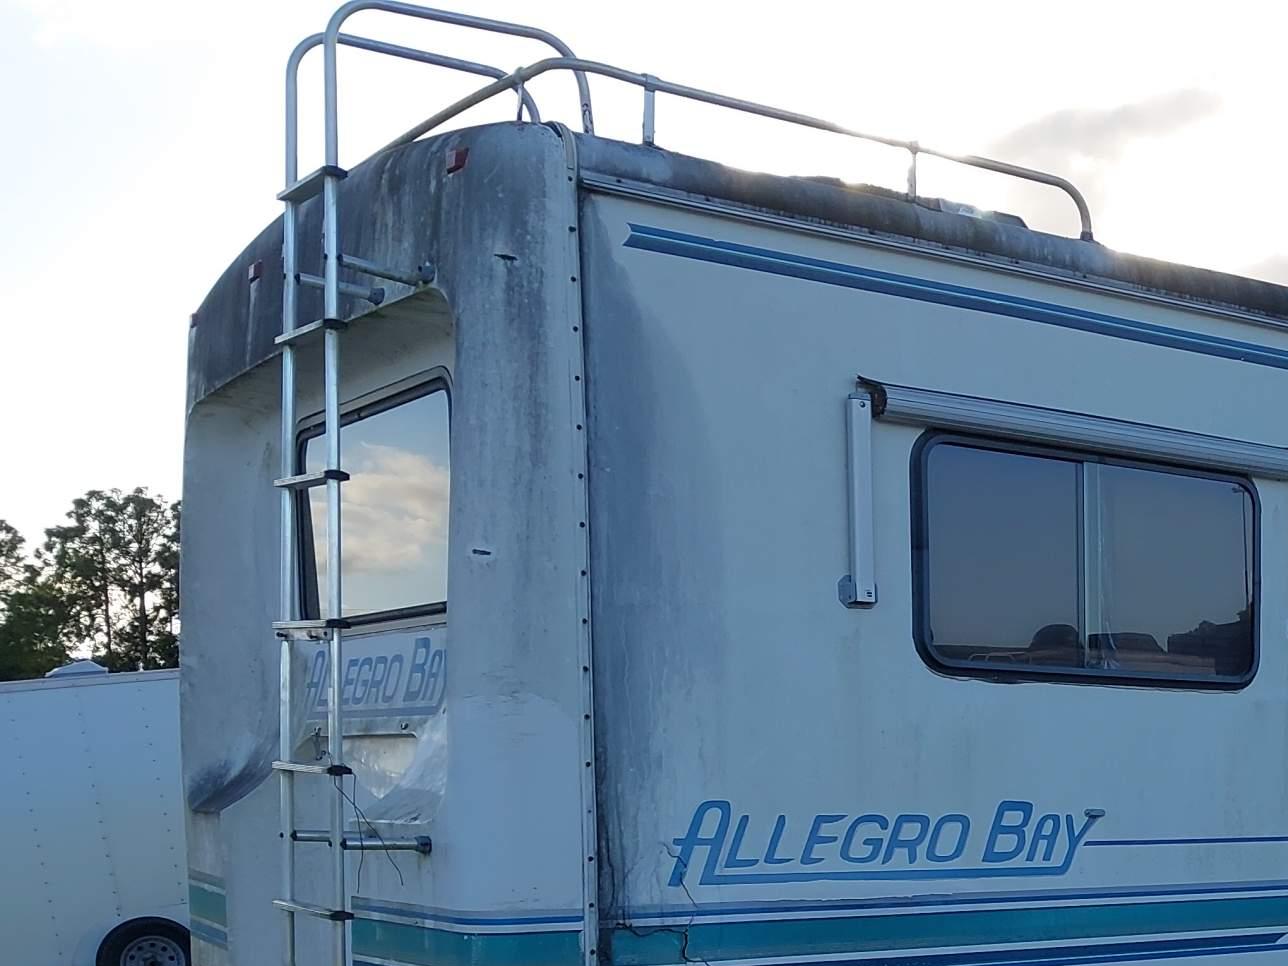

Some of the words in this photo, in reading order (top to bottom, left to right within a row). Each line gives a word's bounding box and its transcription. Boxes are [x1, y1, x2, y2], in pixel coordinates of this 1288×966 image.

[304, 650, 404, 713] ALEGRO
[668, 800, 971, 886] ALLEGRO
[982, 800, 1106, 875] BAY
